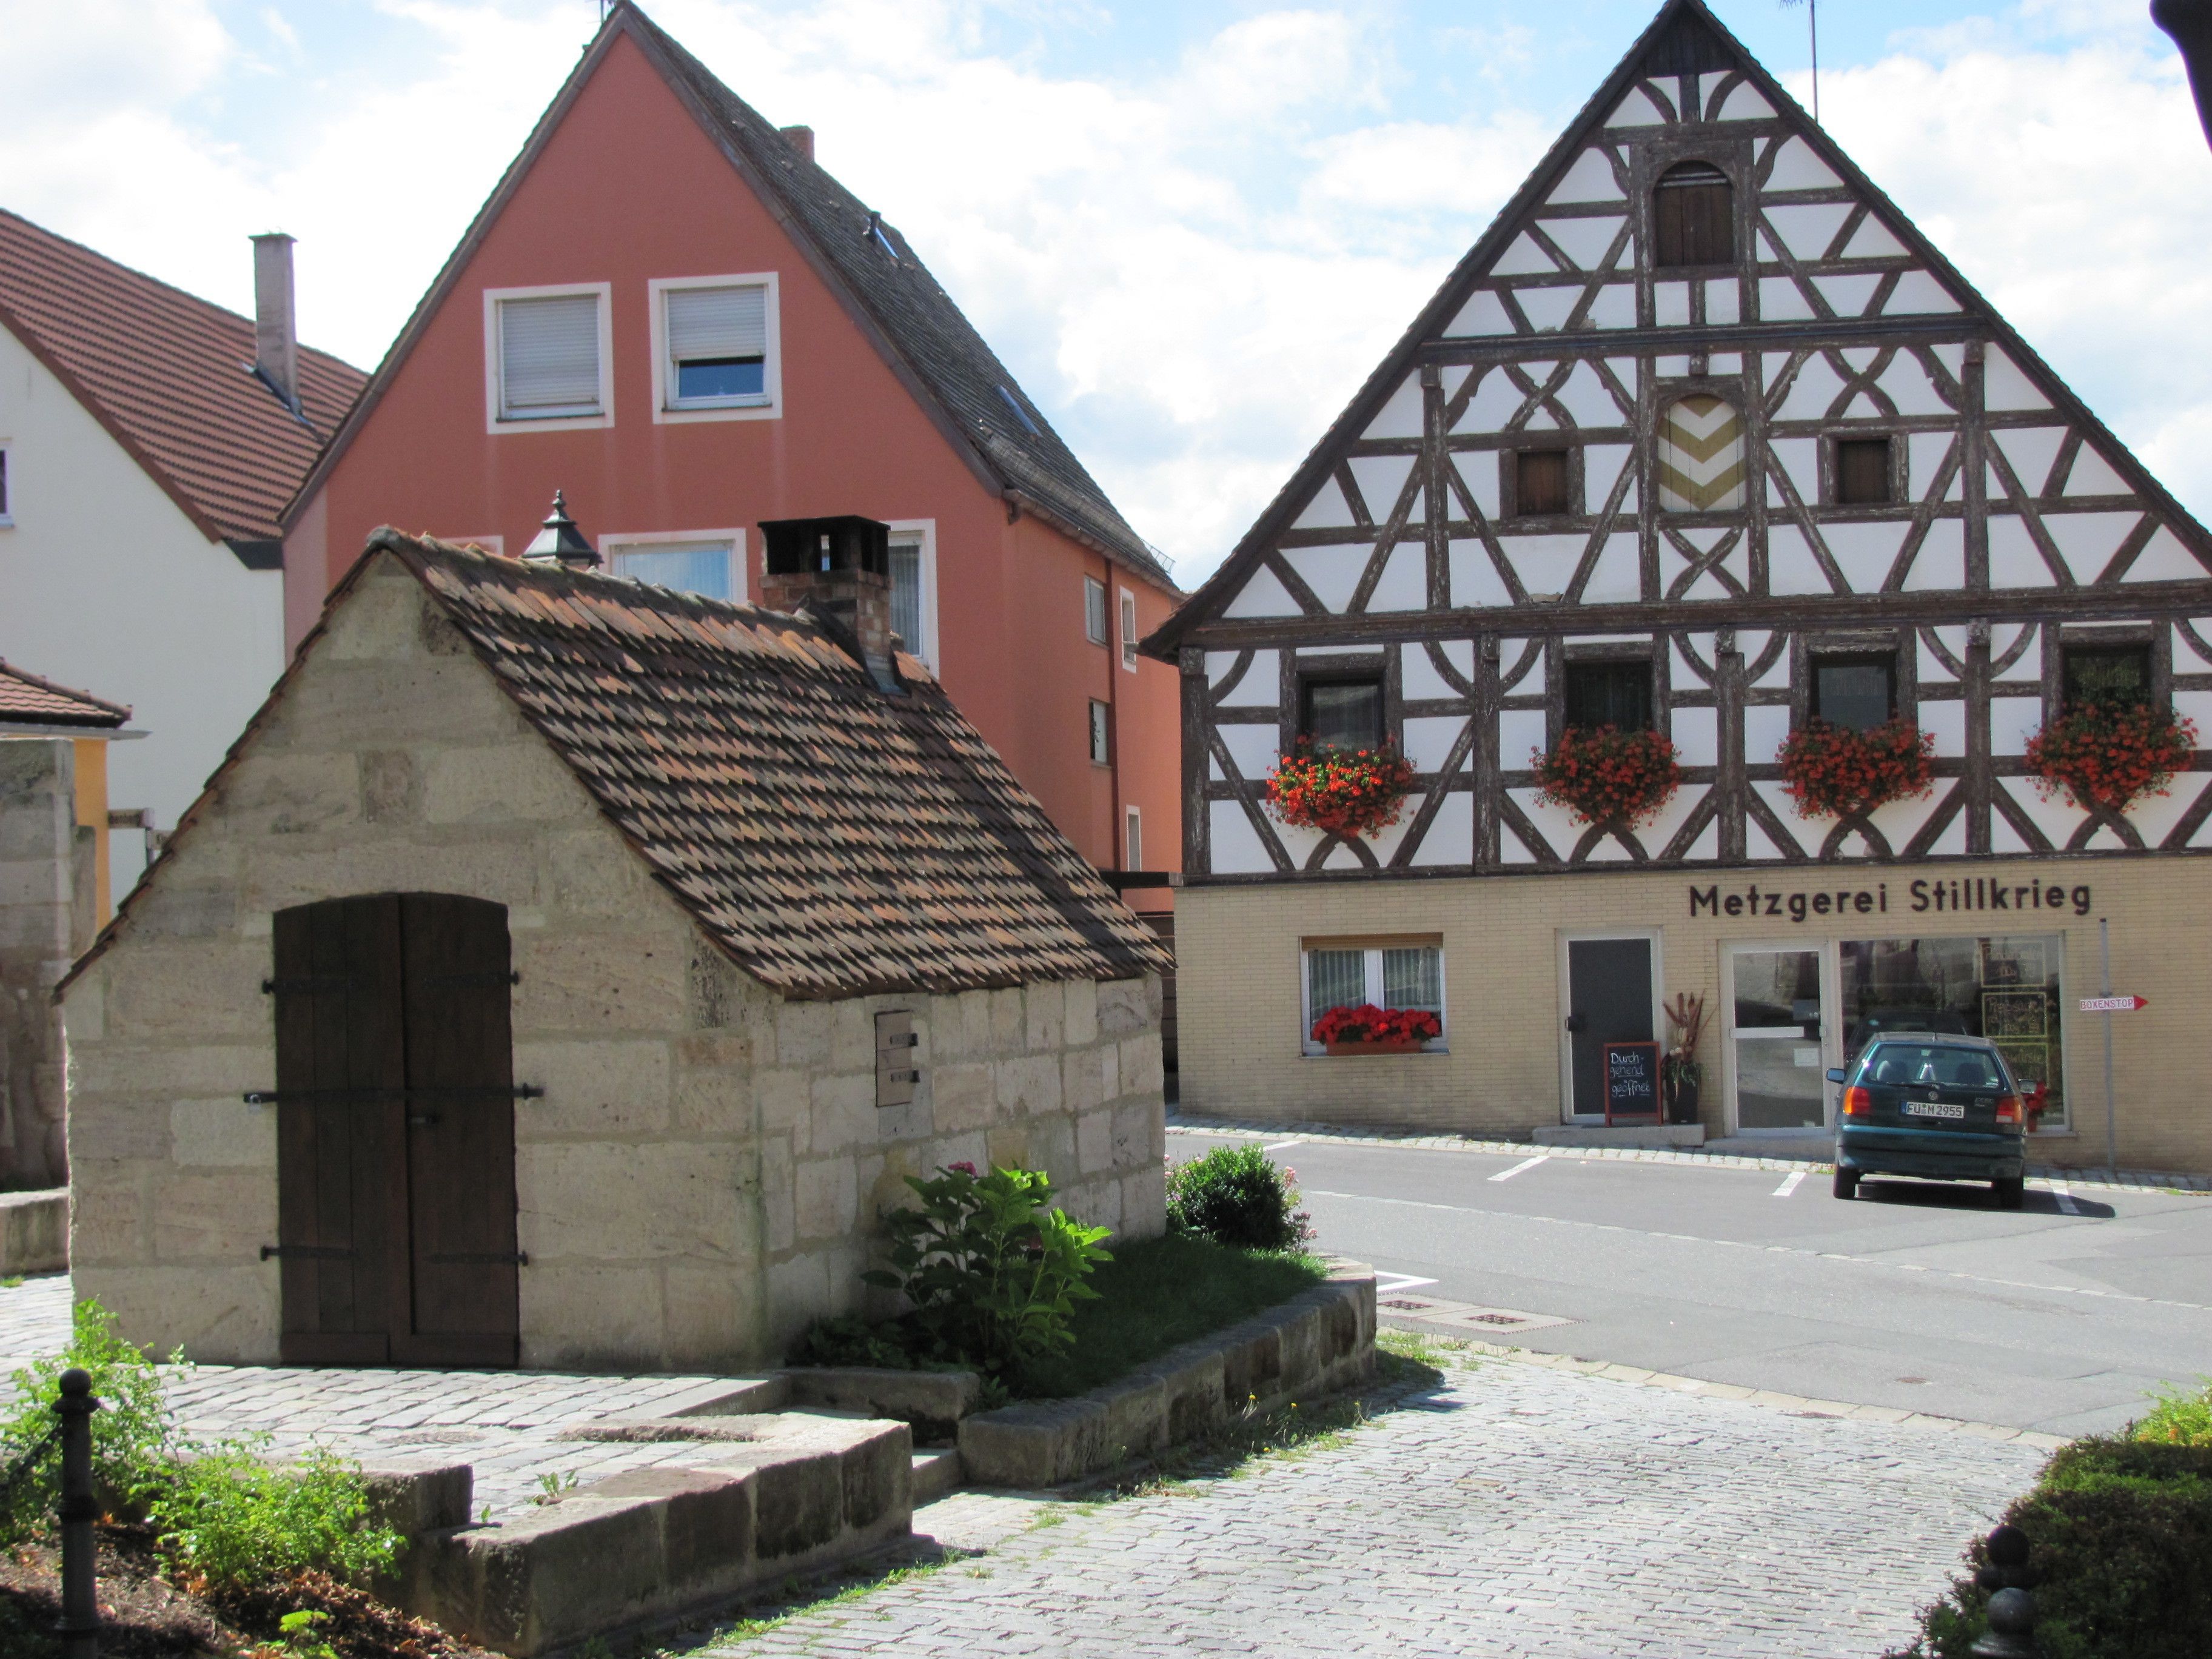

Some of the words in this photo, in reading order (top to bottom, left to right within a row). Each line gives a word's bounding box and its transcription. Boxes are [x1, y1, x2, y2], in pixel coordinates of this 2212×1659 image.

[1689, 883, 1888, 922] Metzgerei
[1909, 878, 2090, 916] Stillkrieg
[2080, 999, 2133, 1009] BOXENSTOP
[1936, 1105, 1962, 1117] 2955
